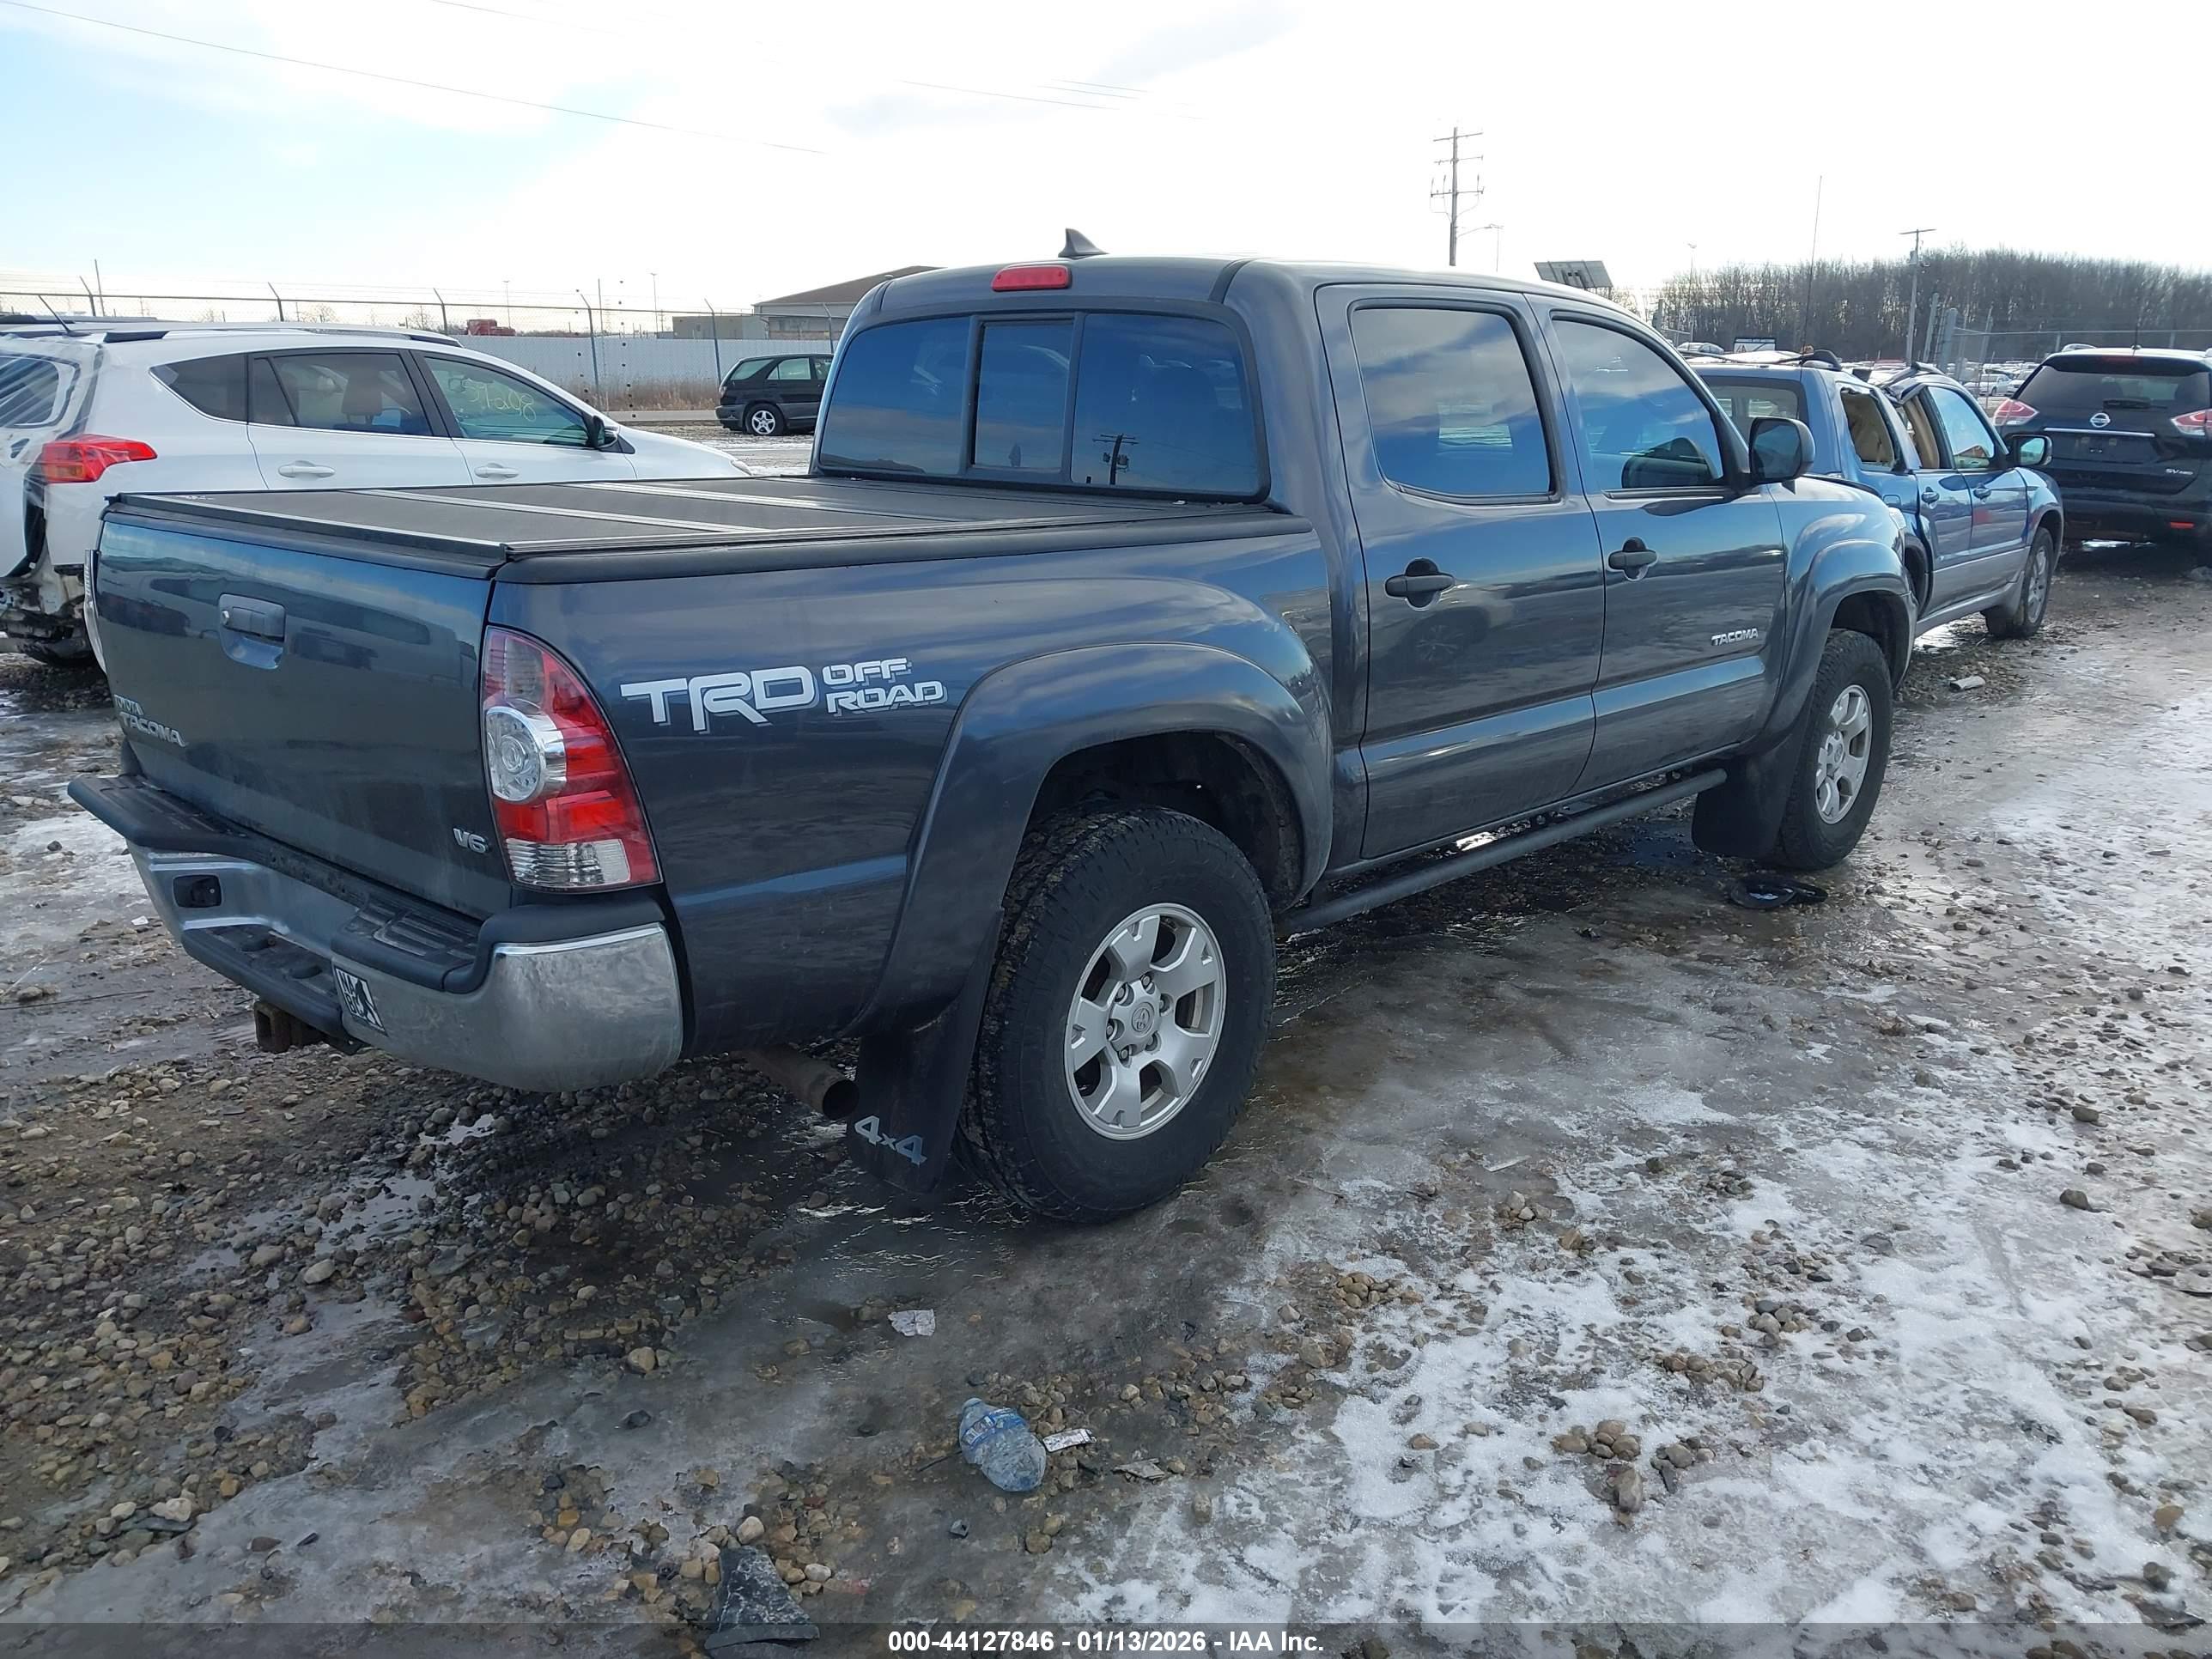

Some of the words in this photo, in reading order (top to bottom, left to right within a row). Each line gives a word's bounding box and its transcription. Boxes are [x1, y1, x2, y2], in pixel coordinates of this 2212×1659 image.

[1711, 628, 1759, 646] TACOMA
[620, 666, 819, 734] TRD
[822, 657, 912, 686] OFF
[826, 680, 947, 716] ROAD
[119, 712, 186, 747] TACOMA
[453, 828, 487, 854] V6
